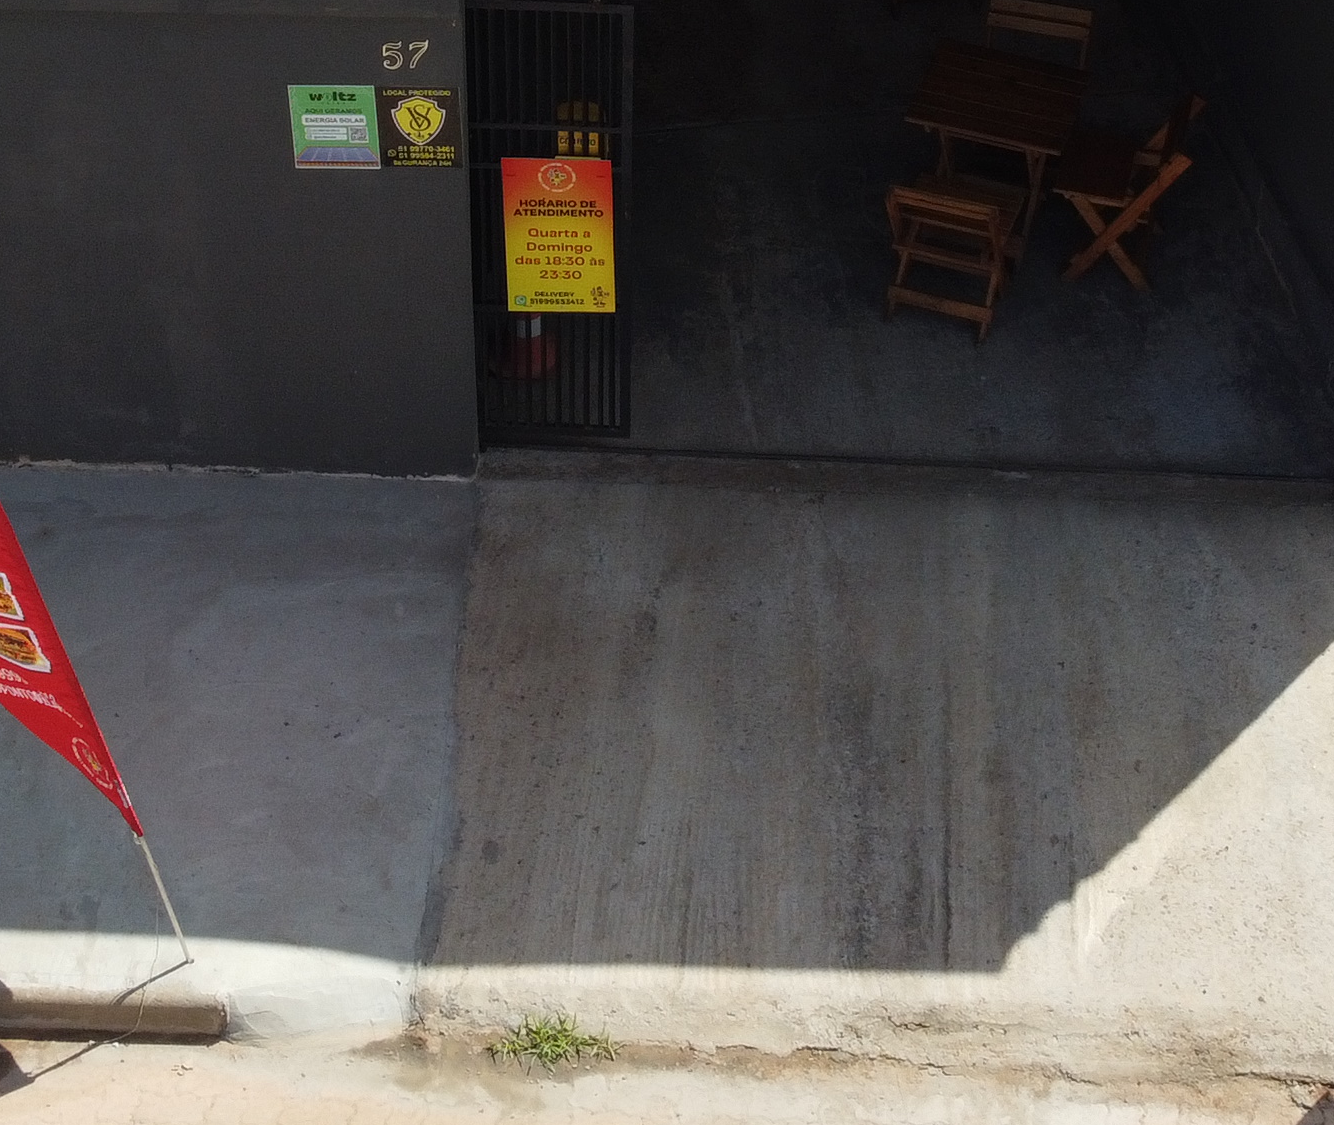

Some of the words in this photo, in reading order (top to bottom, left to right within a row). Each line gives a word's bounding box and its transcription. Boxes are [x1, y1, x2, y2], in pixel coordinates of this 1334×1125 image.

[381, 39, 430, 70] 57
[579, 200, 597, 208] DE
[513, 208, 604, 217] ATENDIMENTO
[528, 228, 578, 238] Quarta
[583, 230, 591, 238] a
[526, 242, 593, 254] Domingo
[515, 255, 541, 265] das
[545, 256, 585, 266] 18:30
